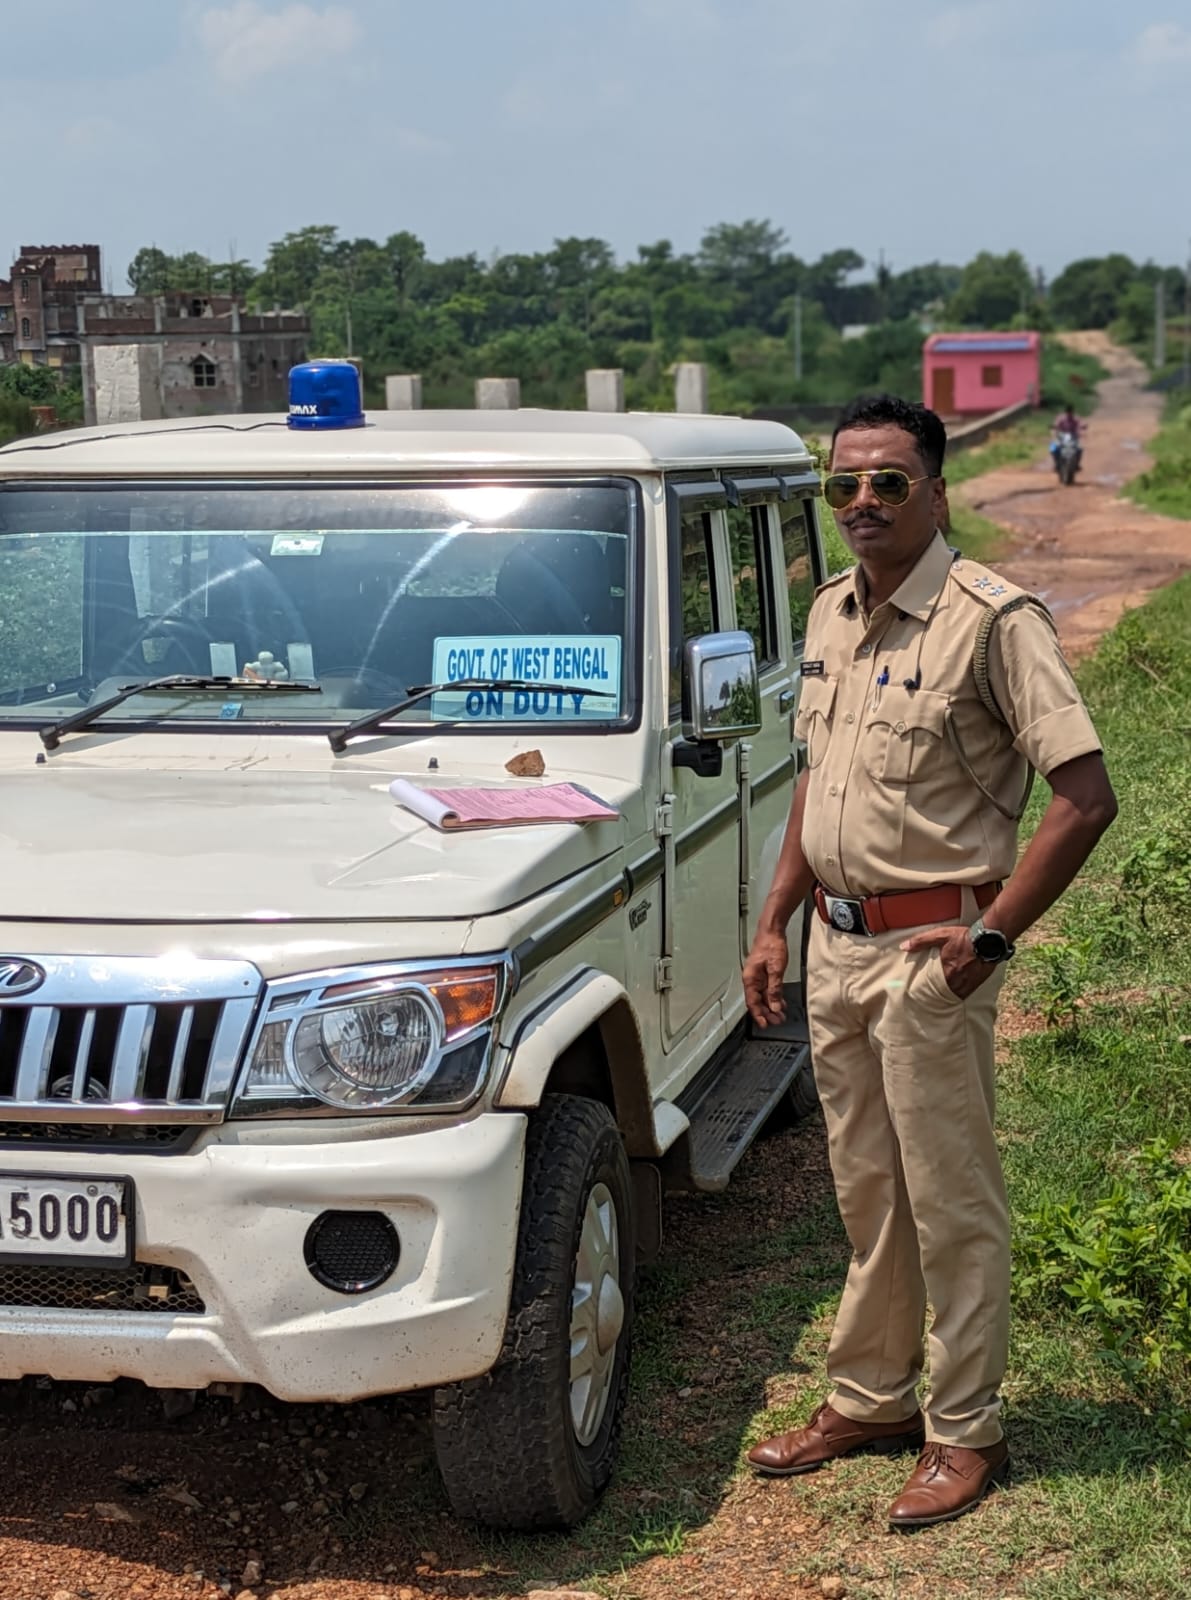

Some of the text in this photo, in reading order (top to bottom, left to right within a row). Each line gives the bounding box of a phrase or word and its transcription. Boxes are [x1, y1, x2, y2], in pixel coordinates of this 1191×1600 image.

[447, 646, 609, 681] GOVT. OF WEST BENGAL
[465, 689, 585, 717] ON DUTY
